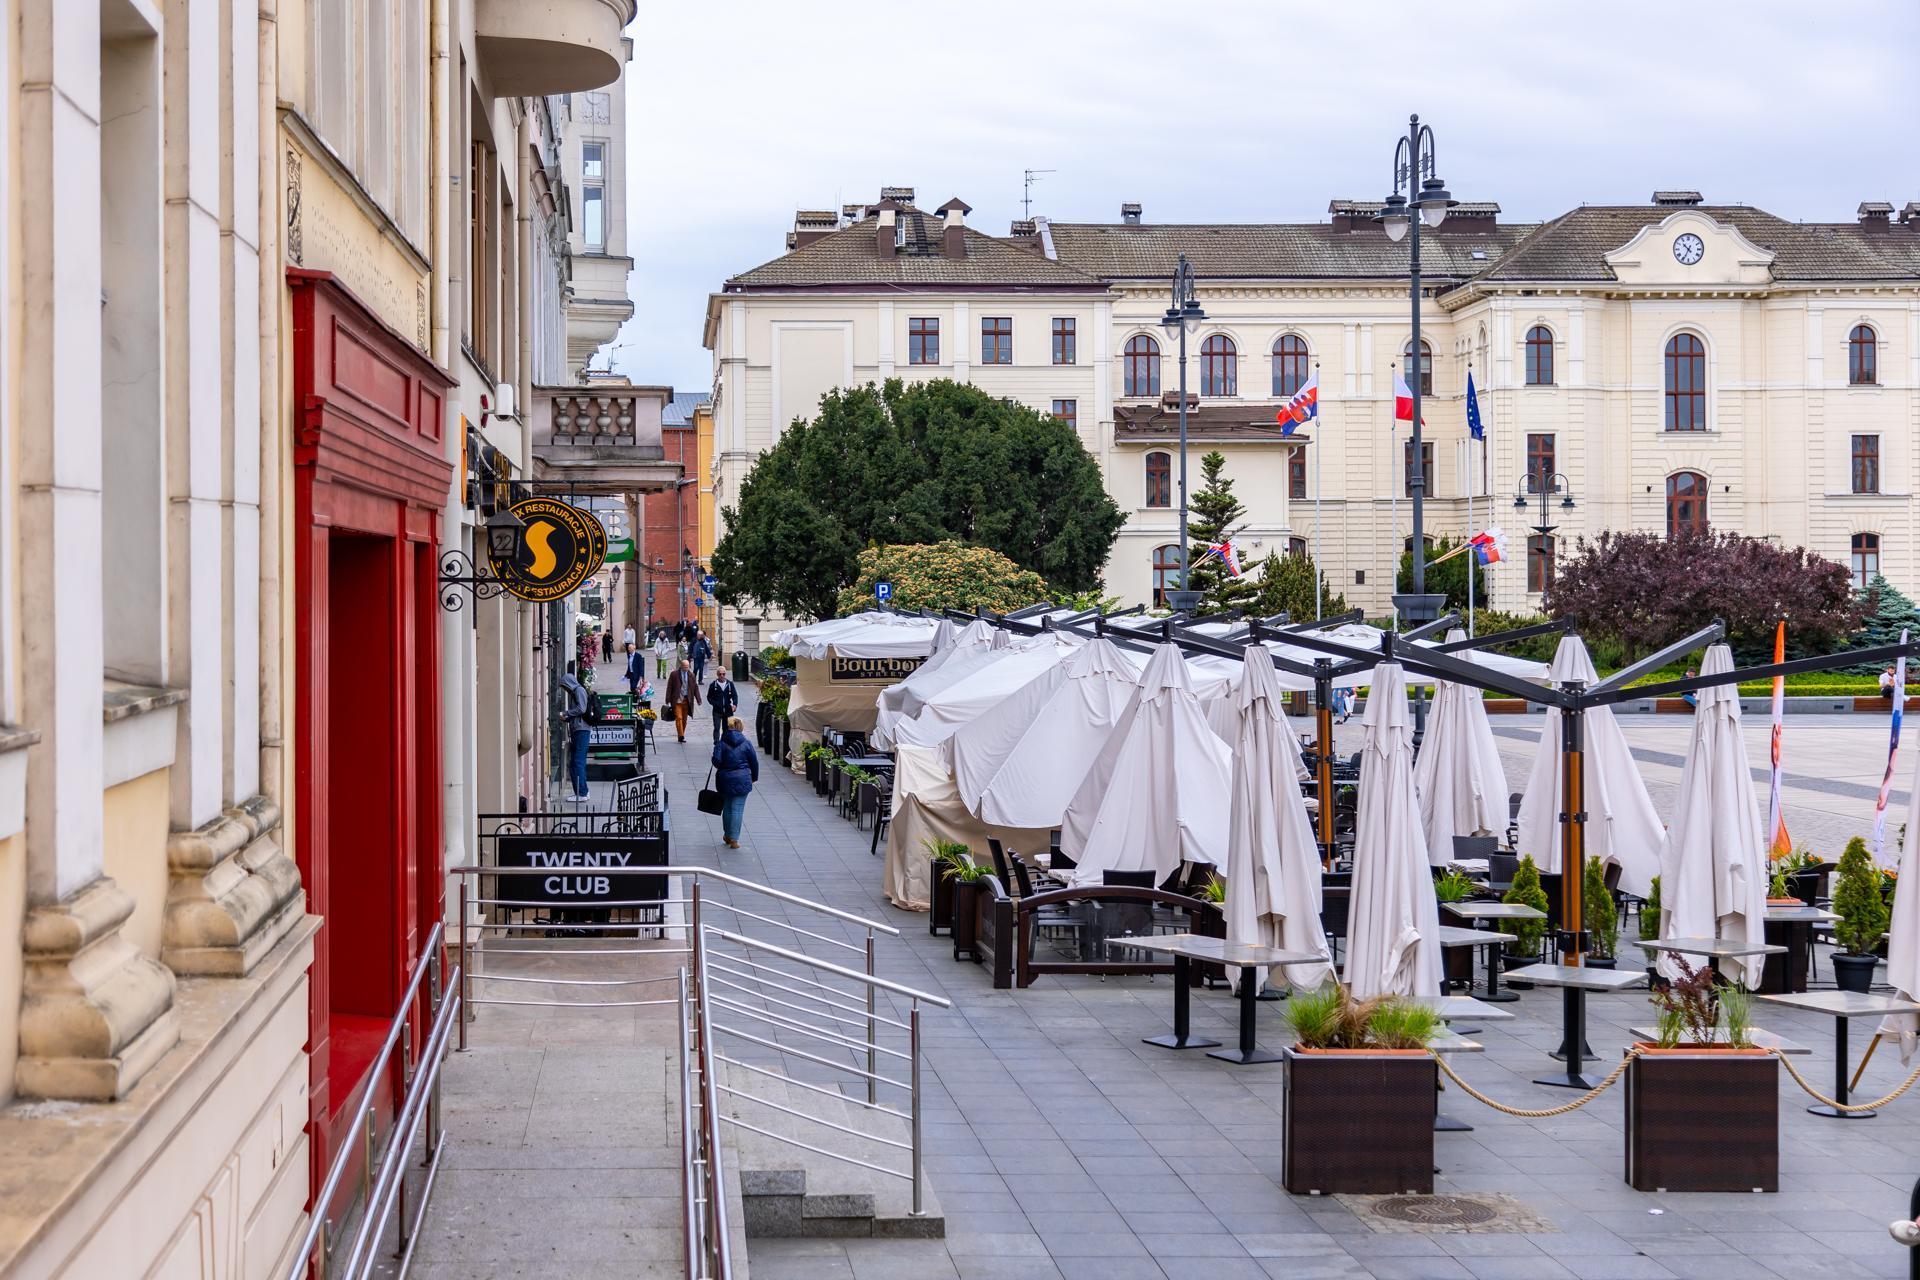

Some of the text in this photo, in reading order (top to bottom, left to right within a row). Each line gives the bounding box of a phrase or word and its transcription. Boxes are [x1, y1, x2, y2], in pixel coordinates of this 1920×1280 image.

[525, 503, 585, 540] RESTAURACJE
[494, 534, 513, 551] 22
[879, 585, 888, 598] P
[526, 851, 632, 868] TWENTY
[544, 876, 611, 895] CLUB
